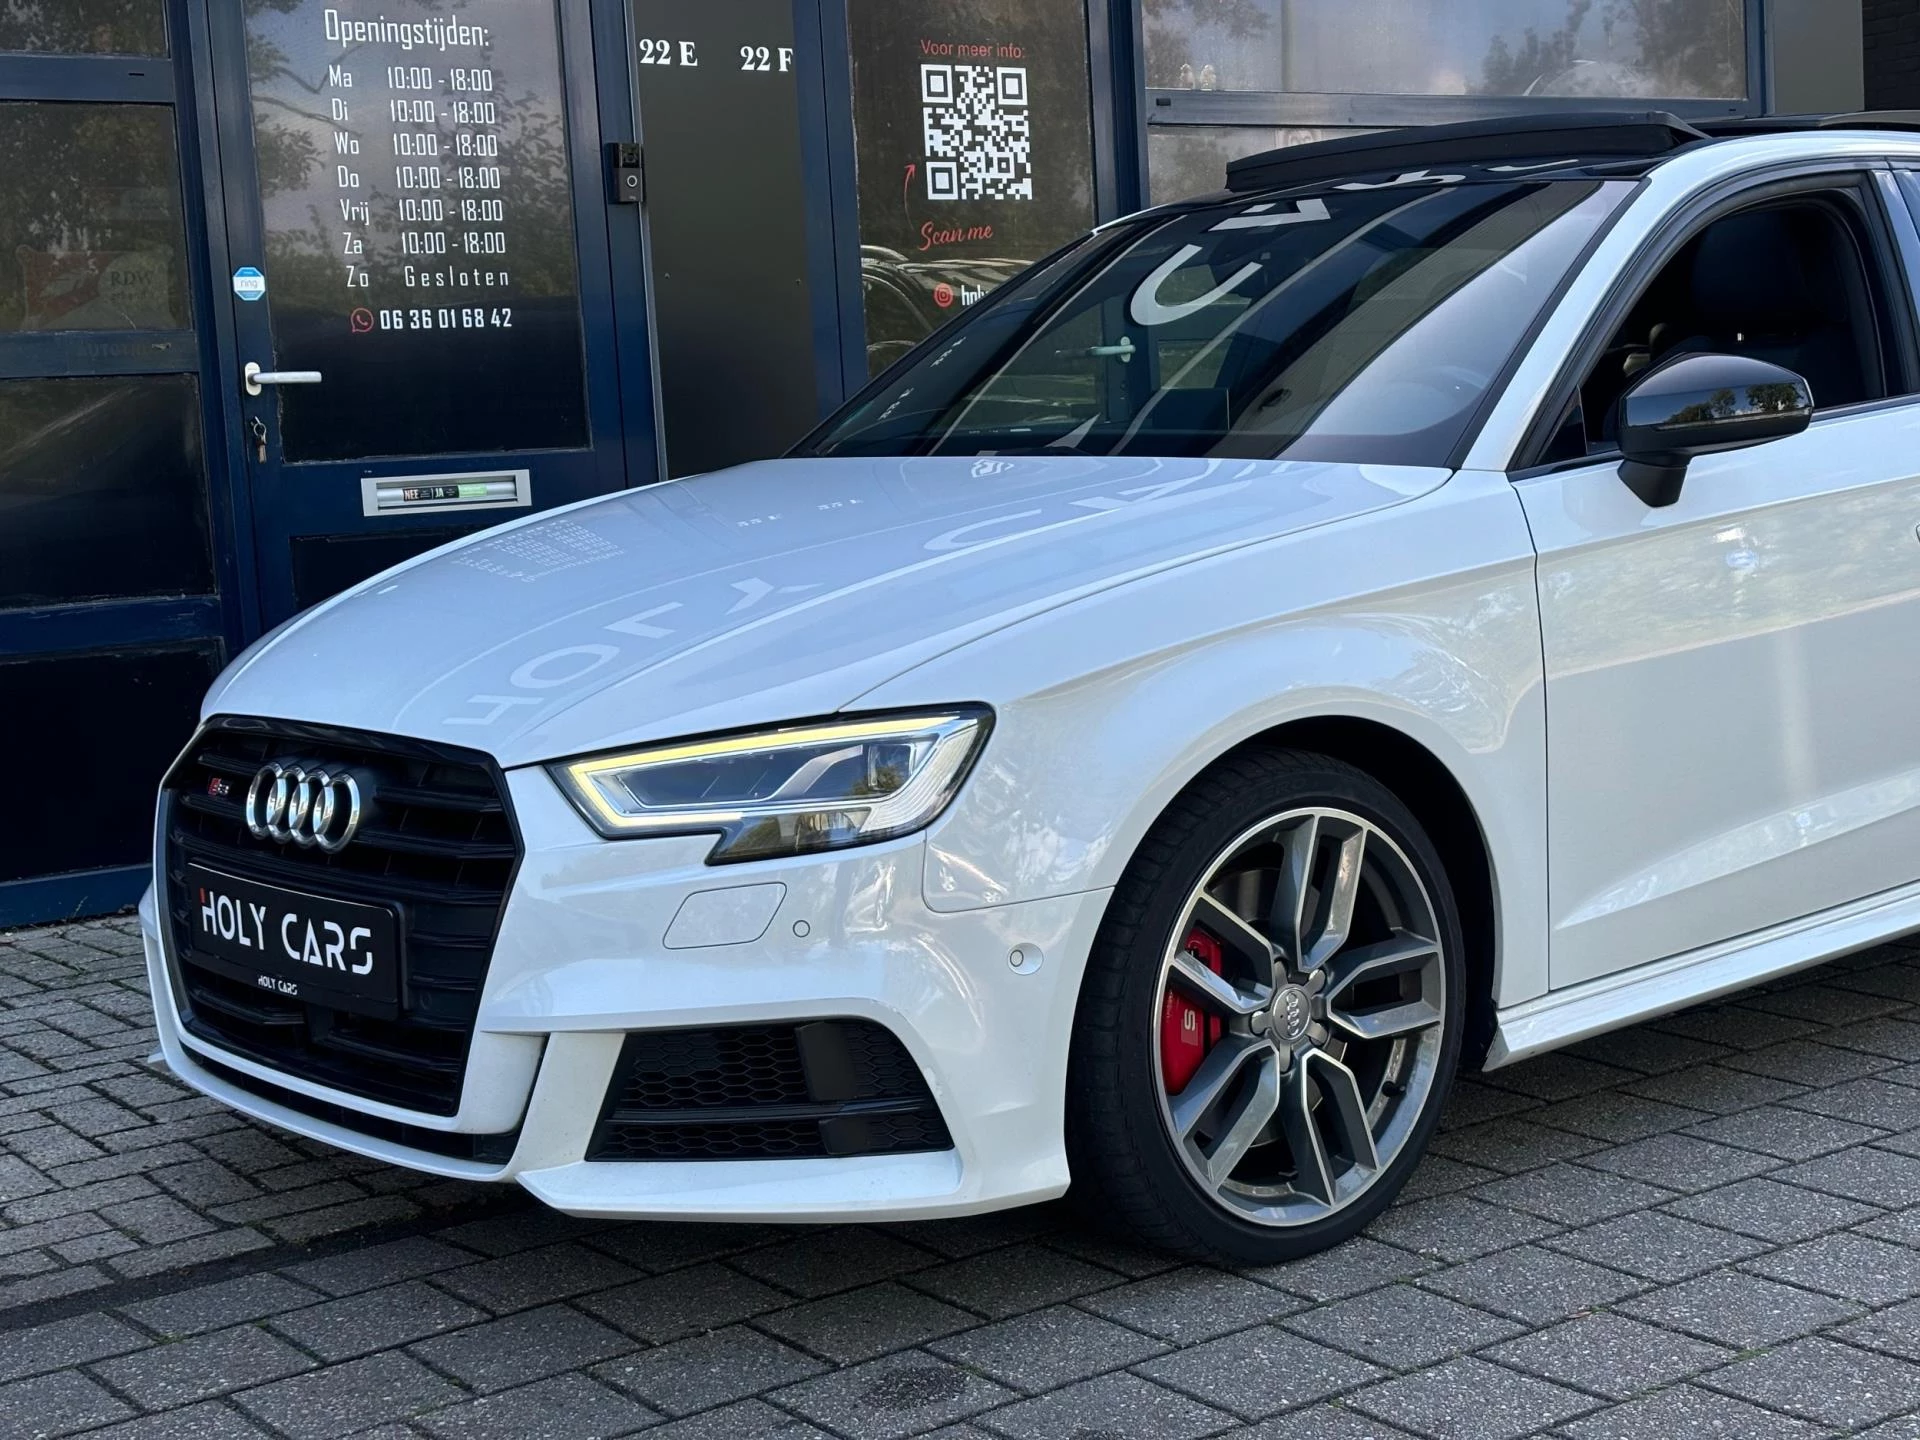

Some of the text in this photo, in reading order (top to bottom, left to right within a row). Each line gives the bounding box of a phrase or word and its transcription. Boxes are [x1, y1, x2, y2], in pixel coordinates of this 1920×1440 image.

[324, 9, 490, 51] Openingstijden:
[639, 38, 698, 67] 22 E
[740, 46, 794, 72] 22 F
[920, 39, 1025, 58] Voor meer info:
[328, 64, 353, 88] Ma
[387, 66, 432, 90] 10:00
[450, 68, 493, 92] 18:00
[331, 98, 349, 121] Di
[390, 99, 435, 123] 10:00
[452, 101, 495, 124] 18:00
[334, 131, 360, 155] Wo
[393, 133, 438, 156] 10:00
[455, 134, 498, 157] 18:00
[337, 165, 360, 188] Do
[396, 166, 440, 189] 10:00
[458, 167, 500, 189] 18:00
[340, 199, 370, 225] Vrij
[399, 199, 443, 222] 10:00
[461, 200, 503, 222] 18:00
[343, 232, 363, 254] Za
[401, 232, 446, 254] 10:00
[464, 232, 506, 254] 18:00
[918, 220, 993, 251] Scan me
[240, 280, 258, 289] ring
[346, 265, 509, 288] Zo Gesloten
[380, 308, 512, 329] 06 36 01 68 42
[404, 489, 419, 500] NEE
[435, 488, 444, 498] JA
[200, 887, 373, 976] HOLY CARS
[257, 975, 298, 996] HOLY CARS
[1184, 1009, 1196, 1031] S
